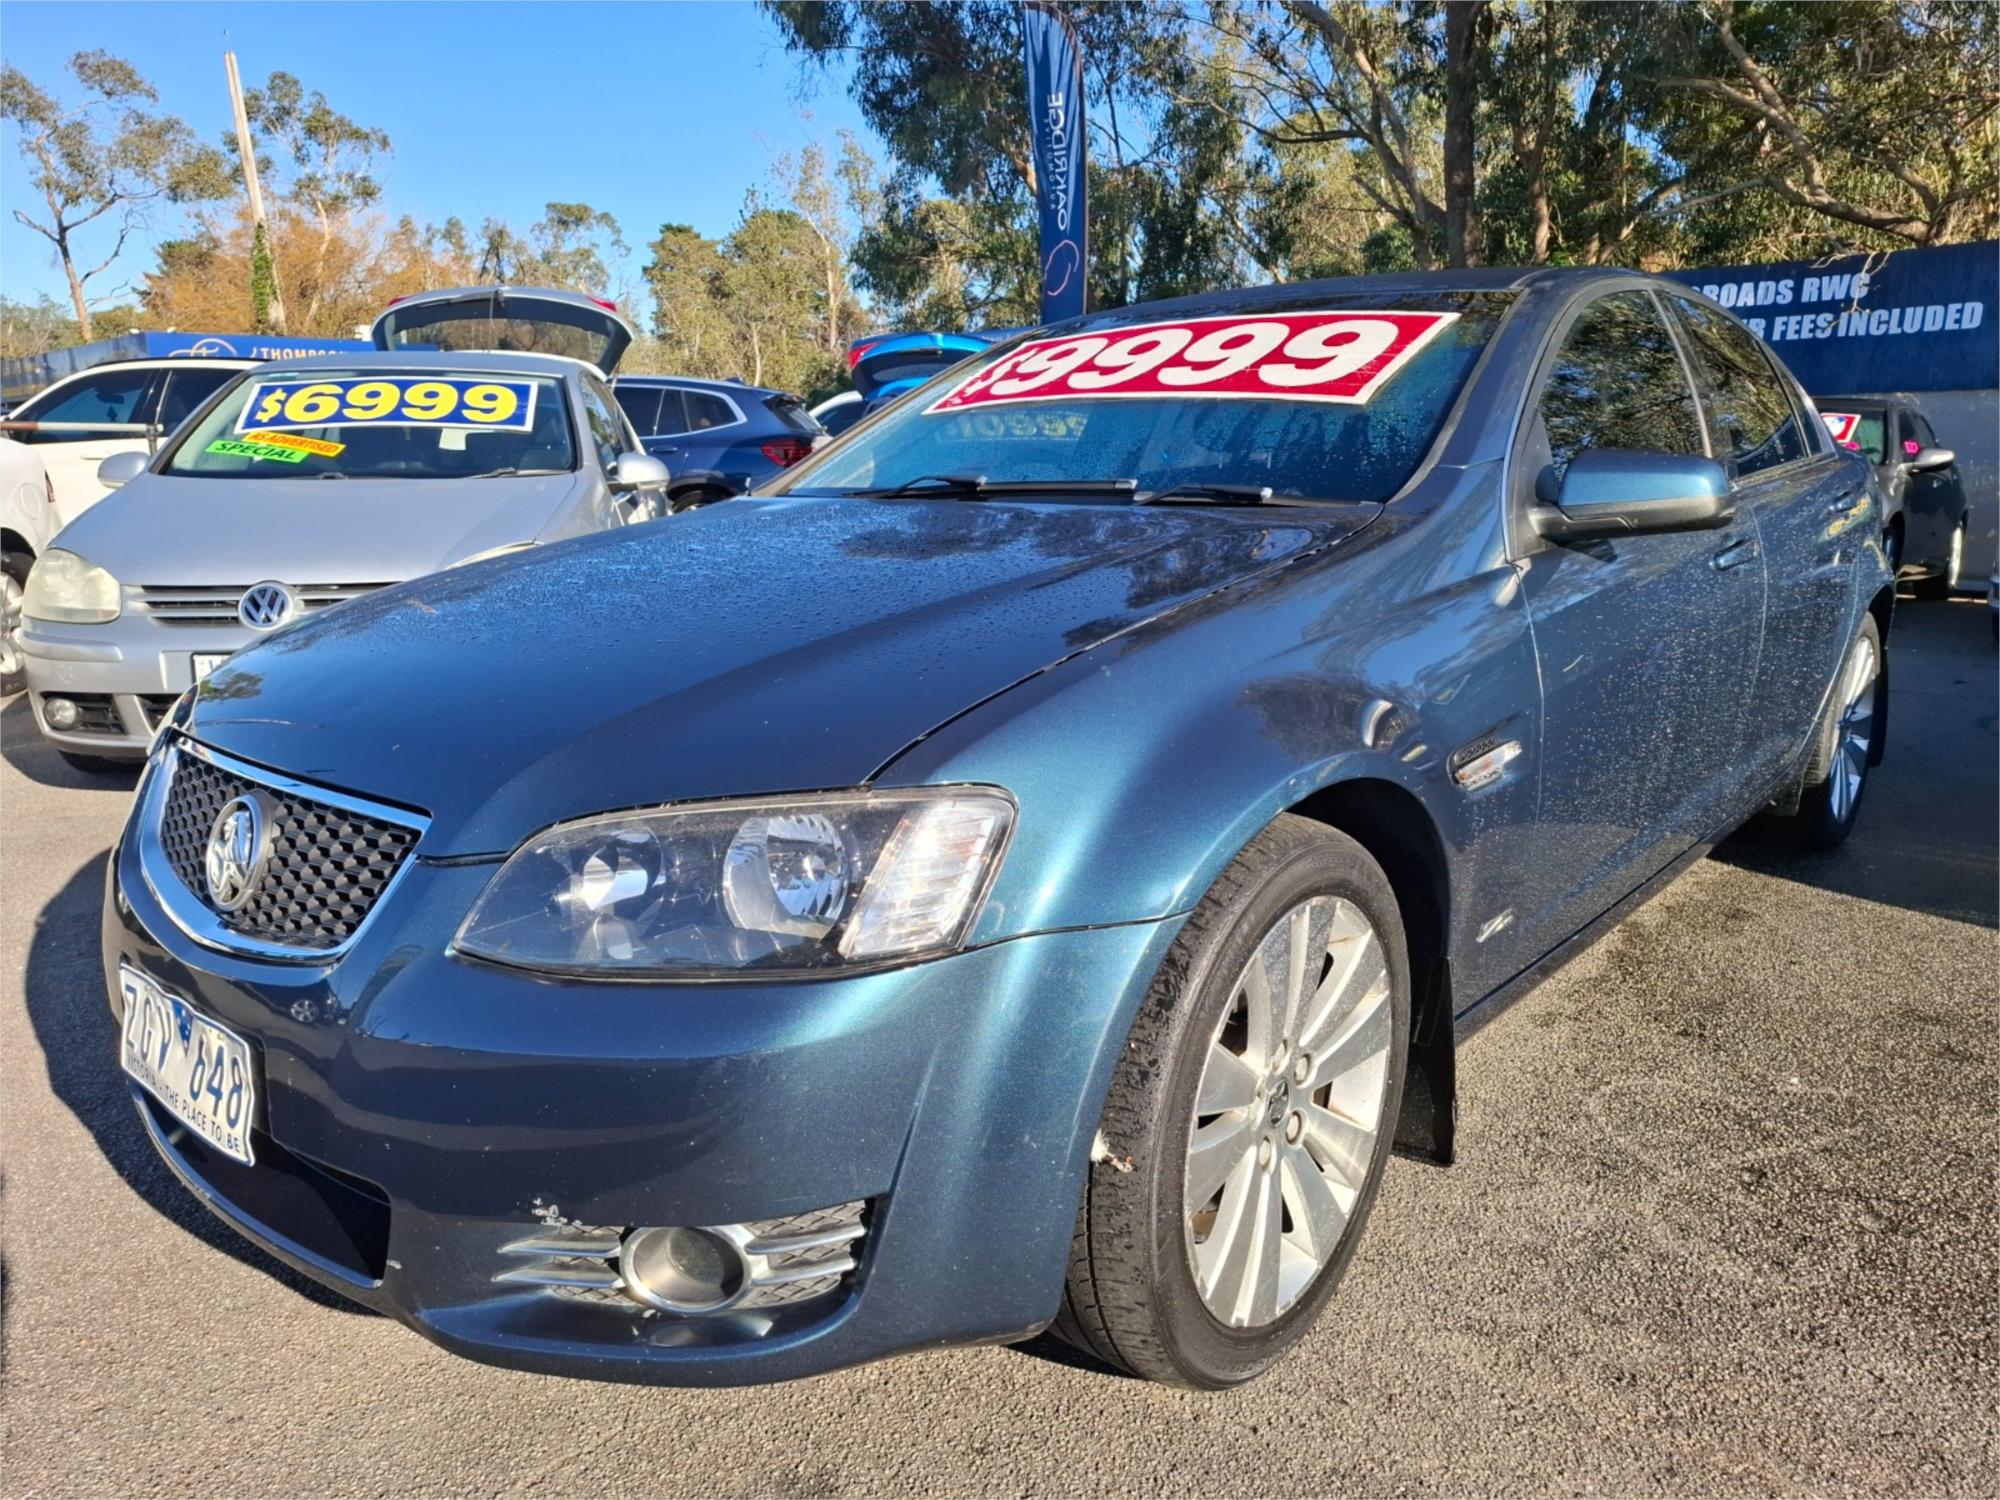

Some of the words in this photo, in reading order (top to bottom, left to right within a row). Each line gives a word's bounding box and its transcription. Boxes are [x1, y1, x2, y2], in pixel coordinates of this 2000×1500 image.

[1691, 279, 1794, 308] ROADS
[1772, 312, 1834, 341] FEES
[1837, 301, 1984, 338] INCLUDED
[964, 319, 1398, 395] $9999
[254, 382, 518, 423] $6999
[216, 443, 294, 459] SPECIAL
[268, 434, 338, 452] ADVERTISED
[165, 1084, 179, 1109] THE
[182, 1099, 207, 1132] PLACE
[211, 1121, 222, 1142] TO
[227, 1133, 241, 1154] BE
